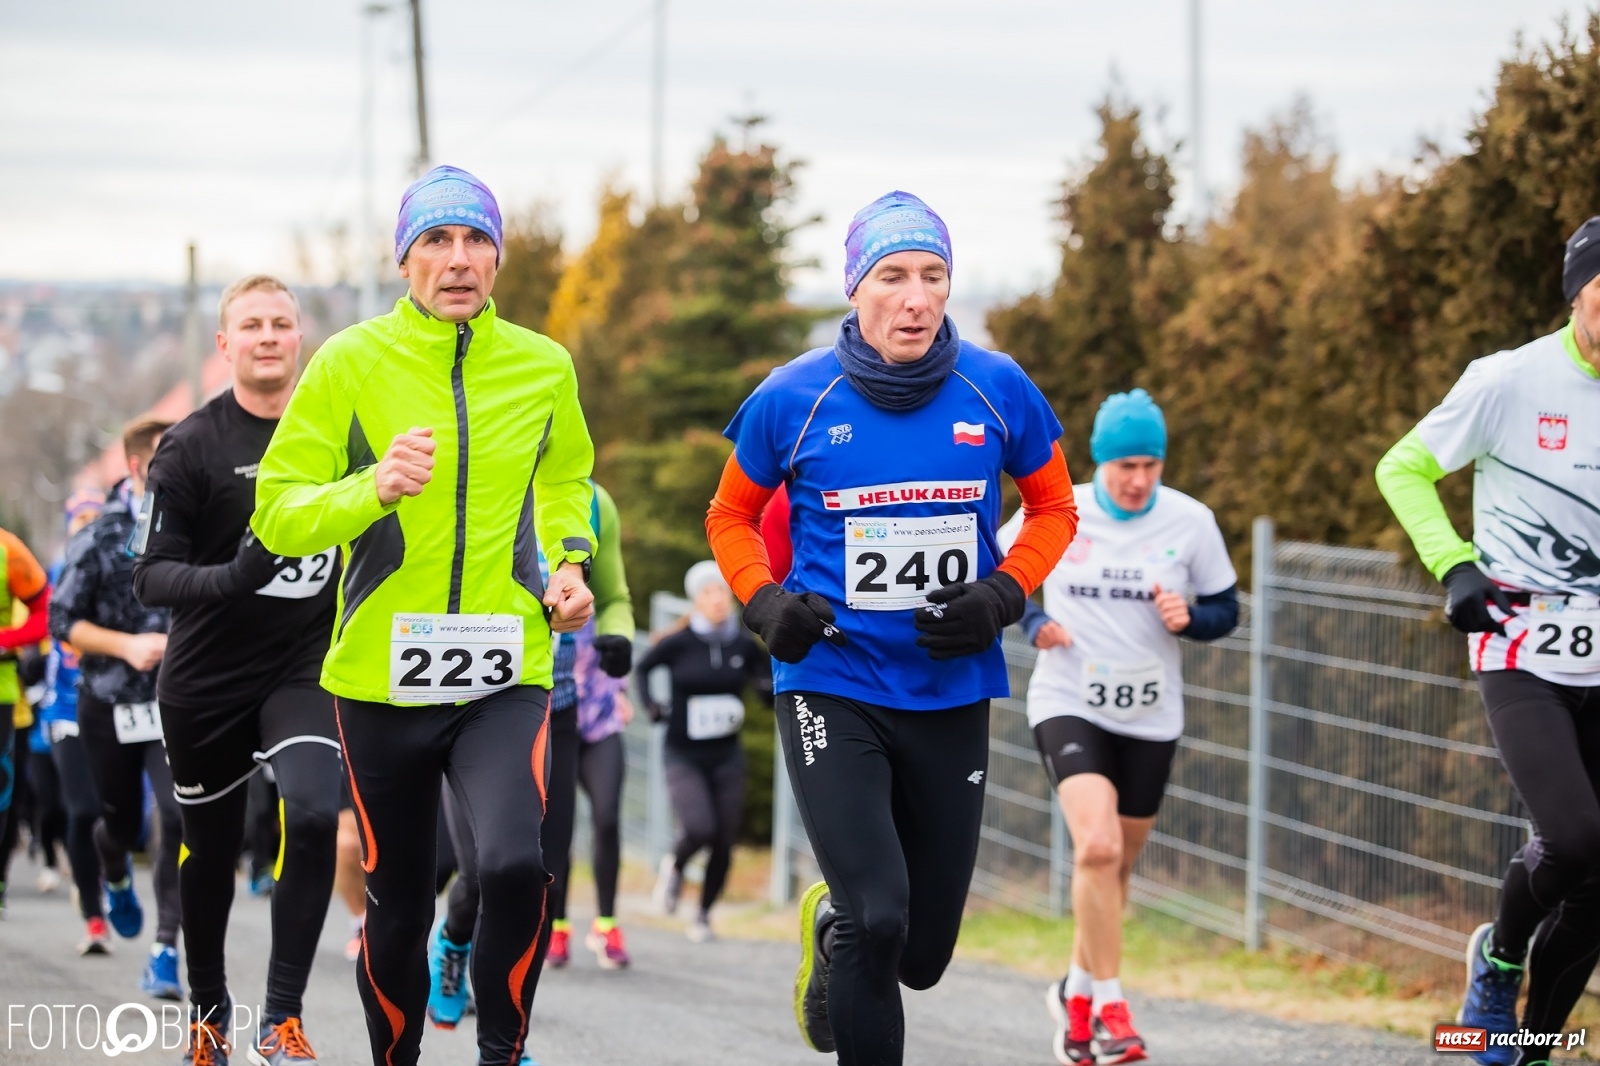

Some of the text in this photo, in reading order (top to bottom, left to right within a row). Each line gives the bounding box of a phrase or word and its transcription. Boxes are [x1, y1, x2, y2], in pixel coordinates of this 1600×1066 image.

[858, 486, 981, 506] HELUKABEL
[894, 525, 972, 538] www.personalbest.pl
[855, 548, 969, 592] 240
[440, 624, 518, 633] www.personalbest.pl
[398, 647, 513, 687] 223
[1087, 681, 1159, 708] 385
